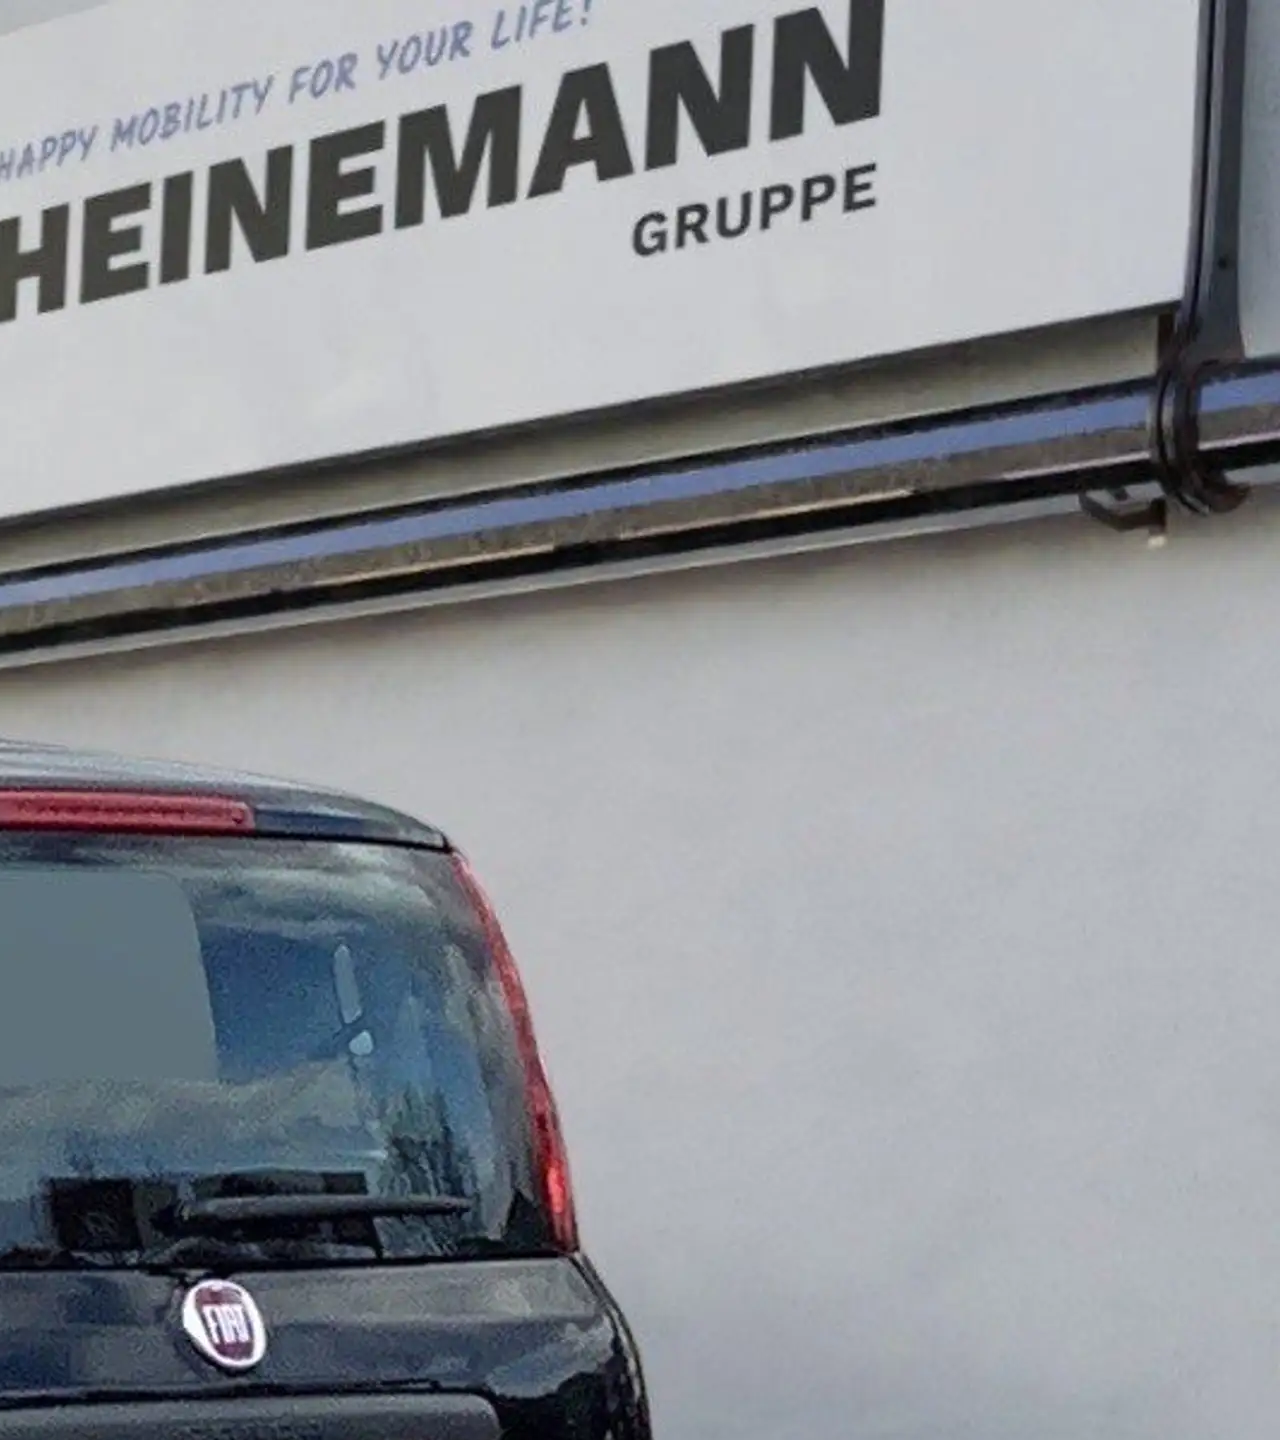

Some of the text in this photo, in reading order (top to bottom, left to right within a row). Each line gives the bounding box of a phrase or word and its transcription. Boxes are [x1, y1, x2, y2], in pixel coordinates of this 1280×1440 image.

[110, 75, 274, 152] MOBILITY
[288, 52, 358, 104] FOR
[376, 20, 474, 80] YOUR
[490, 0, 593, 50] LIFE!
[631, 161, 878, 258] GRUPPE
